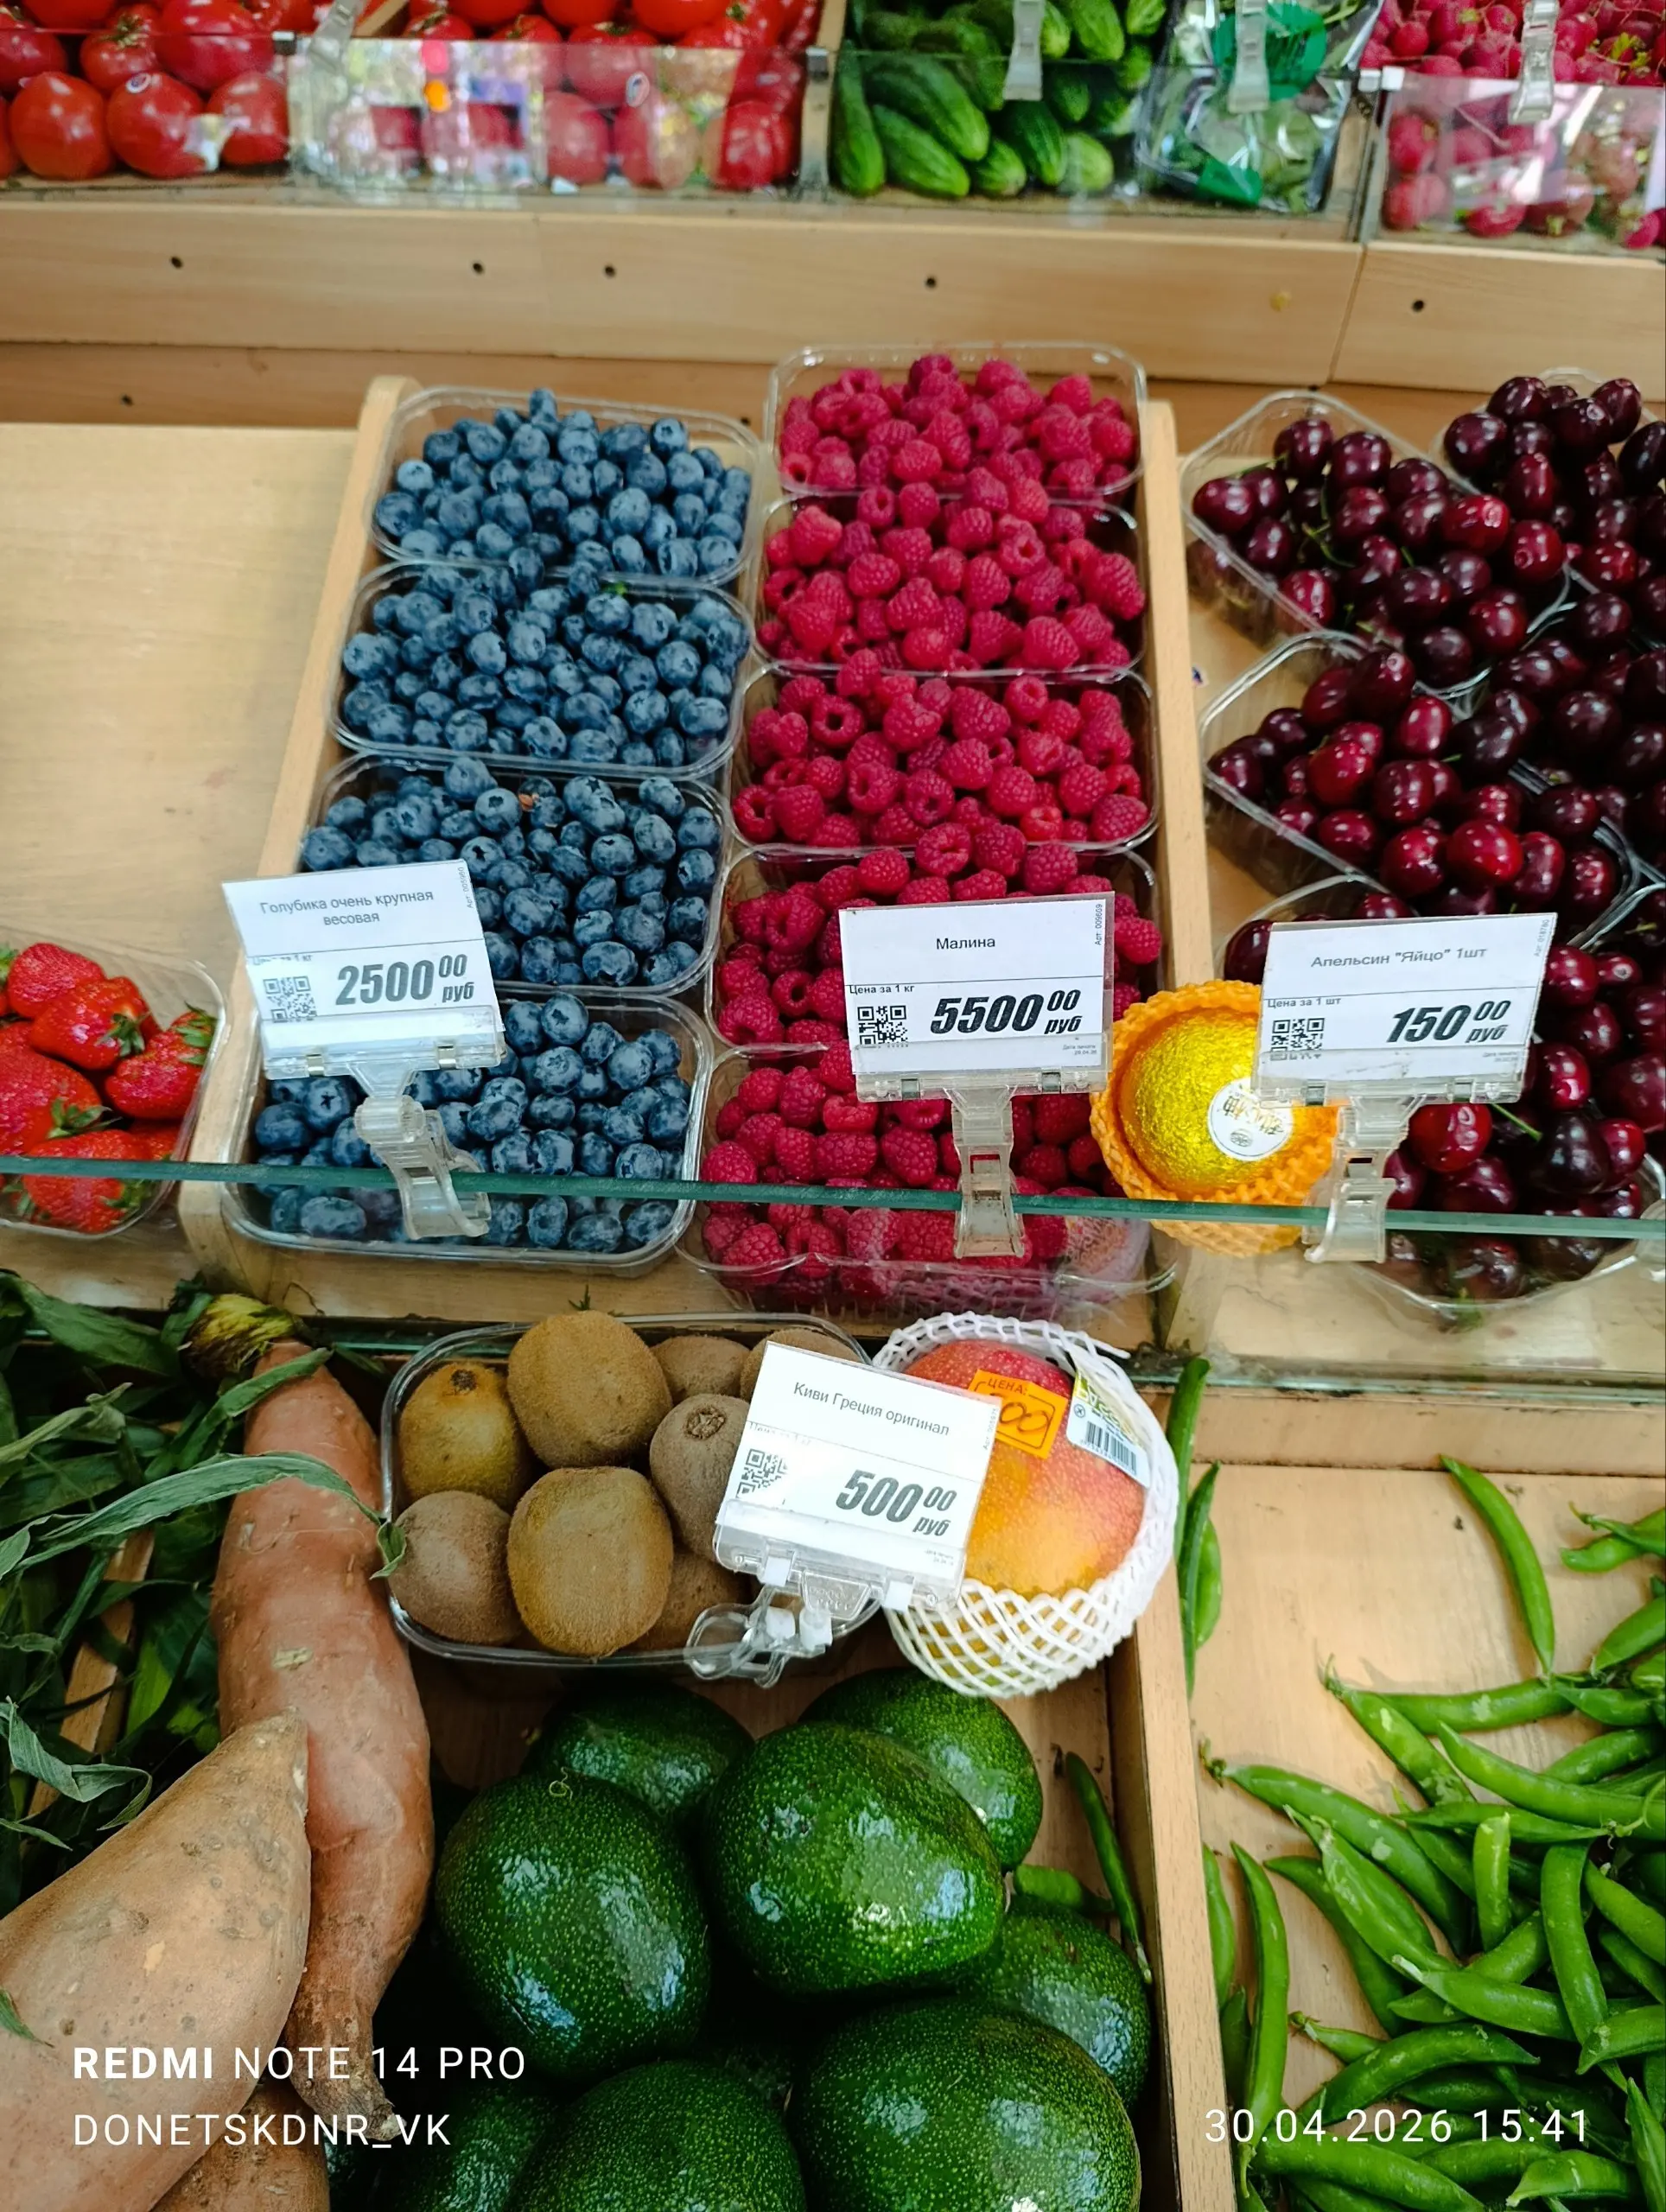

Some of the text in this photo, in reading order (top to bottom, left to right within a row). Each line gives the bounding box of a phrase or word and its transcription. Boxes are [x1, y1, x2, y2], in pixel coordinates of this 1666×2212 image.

[259, 891, 434, 914] Голубика очень крупная
[323, 912, 380, 926] весовая
[936, 937, 995, 950] Малина
[1310, 948, 1487, 968] Апельсин "Яйцо" 1шт
[335, 953, 467, 1006] 2500 00
[849, 984, 877, 995] Цена
[895, 984, 900, 993] 1
[442, 982, 475, 1003] руб
[930, 989, 1082, 1034] 5500 00
[1268, 998, 1297, 1009] Цена
[1316, 997, 1322, 1006] 1
[1044, 1015, 1083, 1035] руб
[1386, 1000, 1512, 1043] 150 00
[1465, 1024, 1510, 1043] руб
[987, 1377, 1029, 1396] ЦЕНА:
[793, 1382, 951, 1436] Киви Греция оригинал
[836, 1469, 957, 1522] 500 00
[912, 1516, 951, 1536] руб
